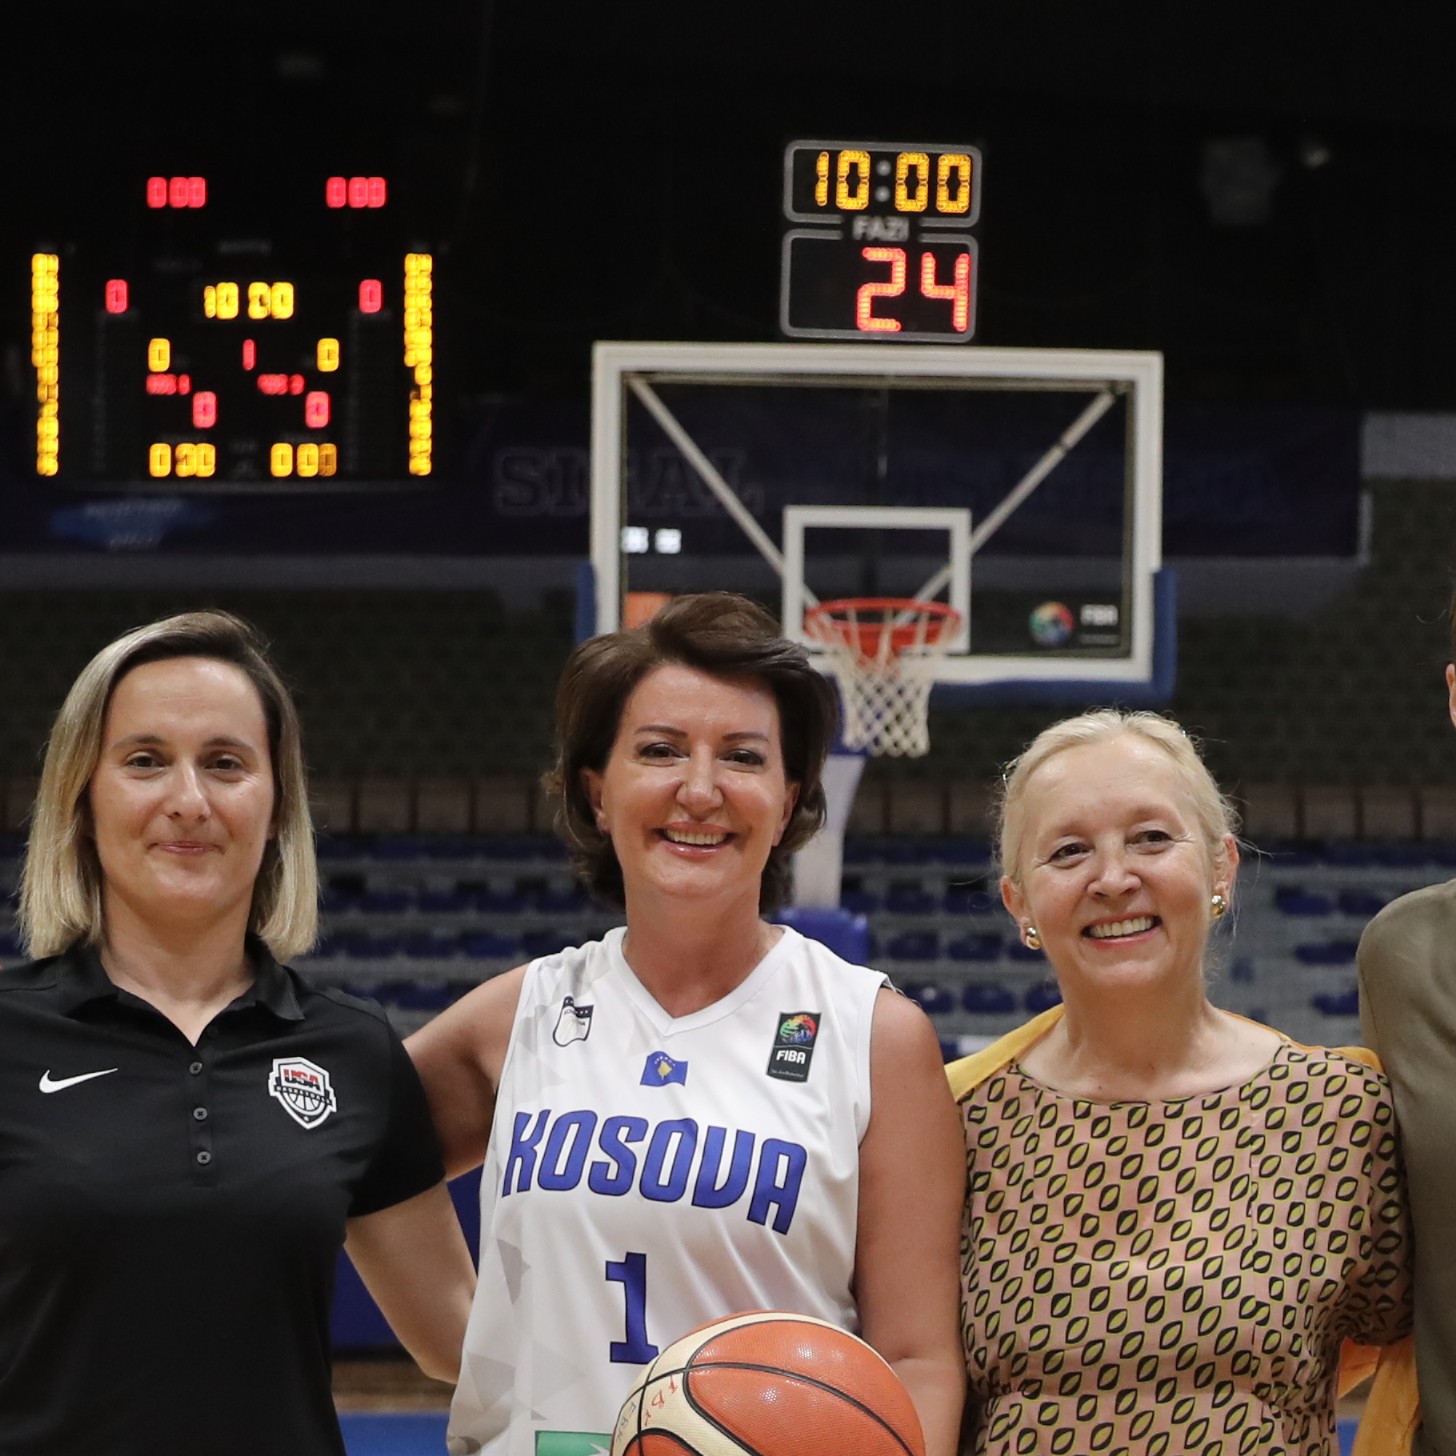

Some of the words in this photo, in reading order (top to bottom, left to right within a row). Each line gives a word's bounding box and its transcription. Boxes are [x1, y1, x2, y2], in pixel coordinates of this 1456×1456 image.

[815, 150, 971, 213] 10:00
[857, 247, 970, 331] 24
[283, 1069, 322, 1091] USA
[776, 1050, 807, 1064] FIBA
[502, 1109, 807, 1235] KOSOVA
[605, 1252, 659, 1364] 1
